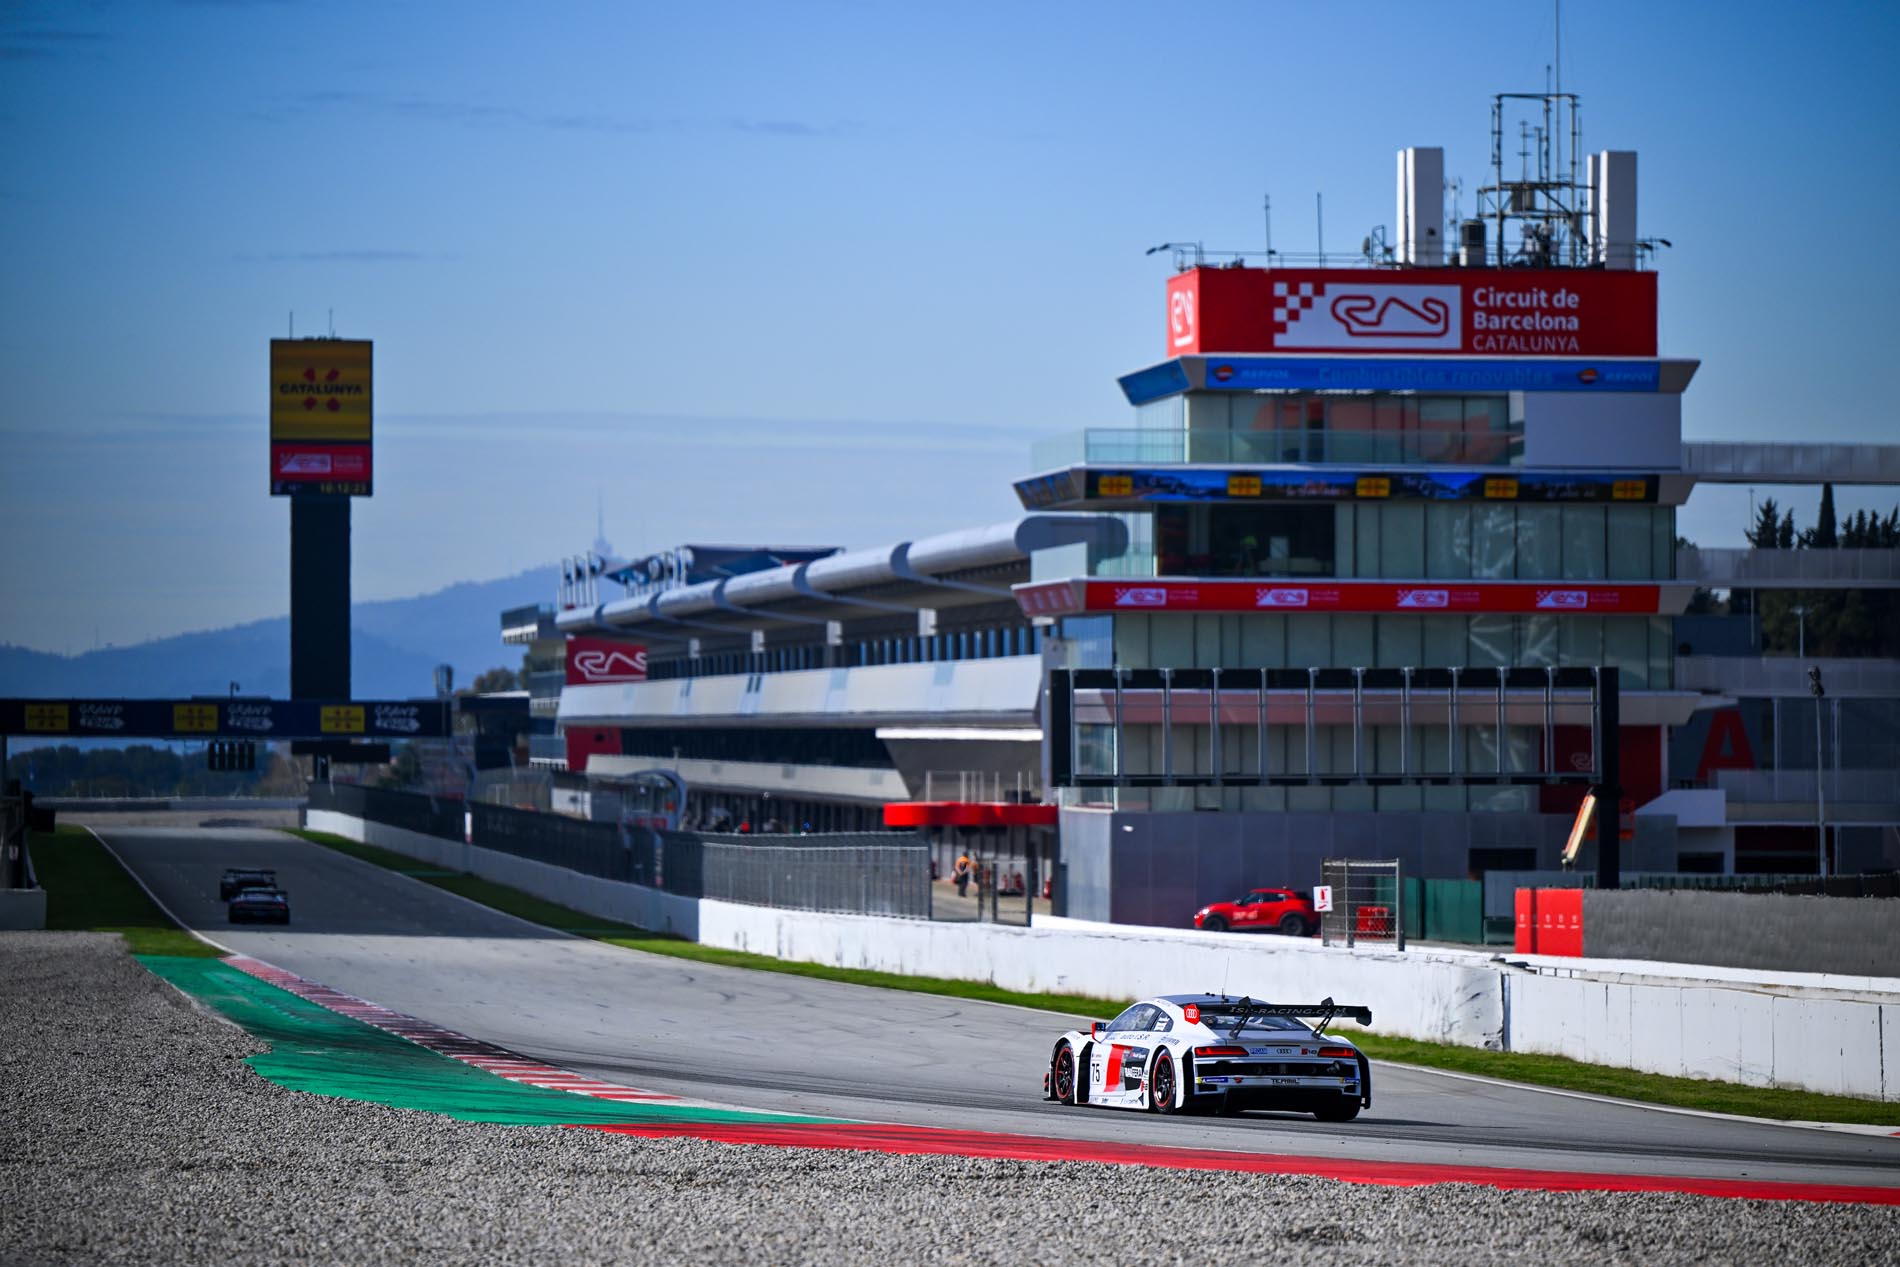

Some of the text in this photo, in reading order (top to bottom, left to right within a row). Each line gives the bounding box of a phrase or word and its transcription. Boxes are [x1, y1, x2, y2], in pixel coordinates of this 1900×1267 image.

[1473, 286, 1581, 309] Circuit de
[1473, 310, 1581, 331] Barcelona
[1472, 333, 1580, 352] CATALUNYA
[280, 383, 363, 395] CATALUNYA
[1091, 1063, 1101, 1083] 75
